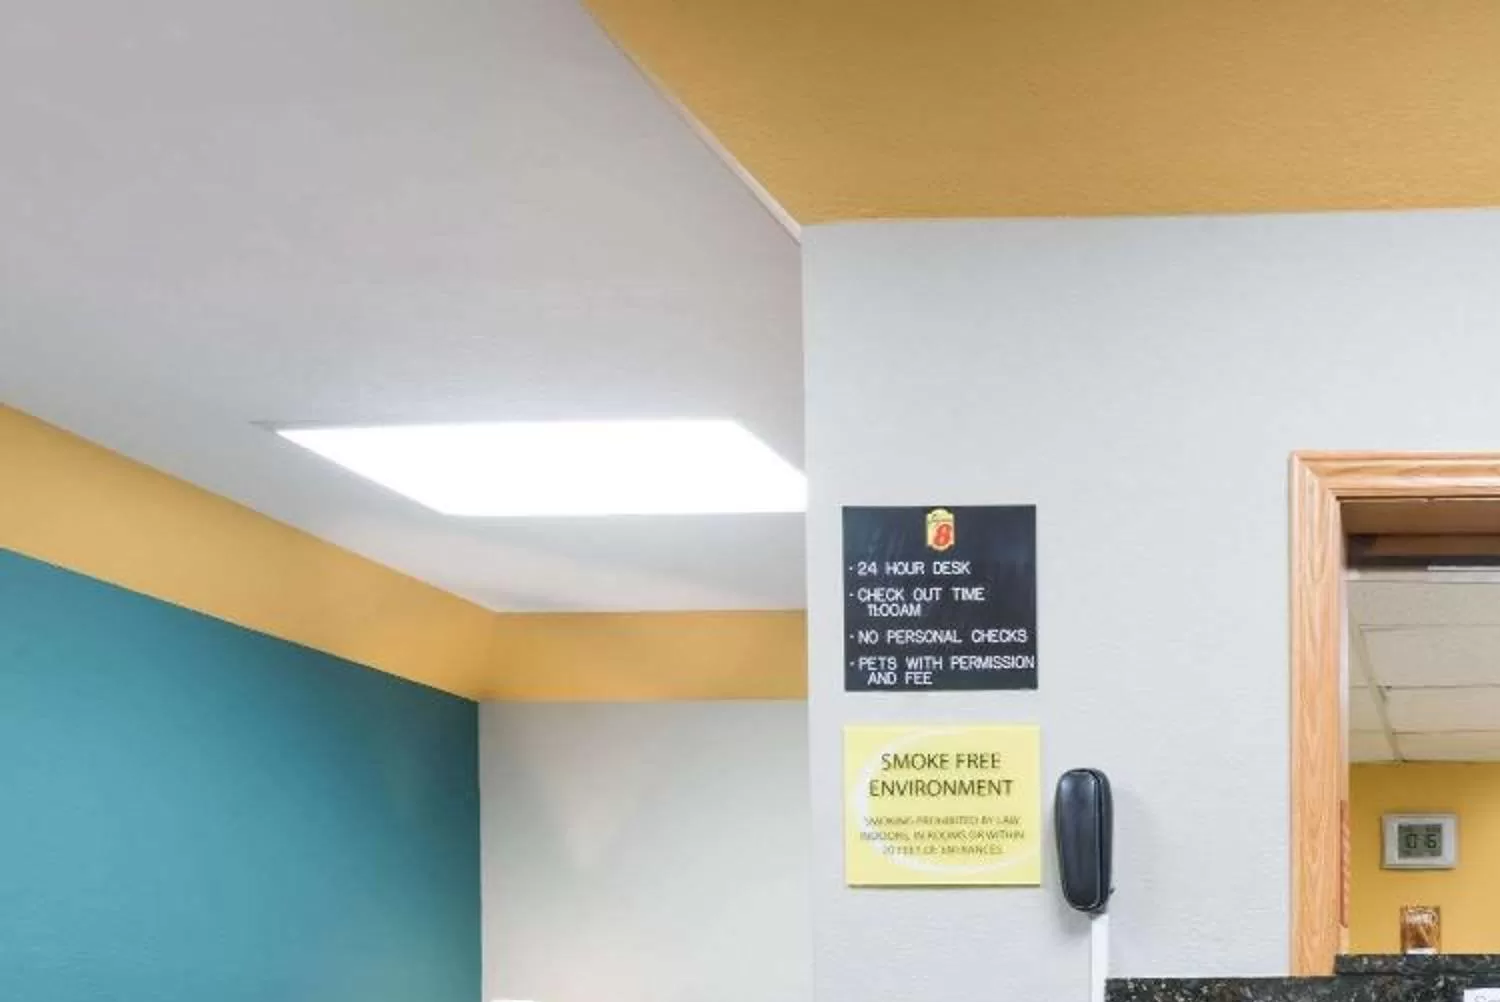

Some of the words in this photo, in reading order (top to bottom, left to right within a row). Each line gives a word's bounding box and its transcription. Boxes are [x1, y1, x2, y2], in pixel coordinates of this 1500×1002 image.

[857, 562, 878, 575] 24
[886, 561, 925, 575] HOUR
[933, 561, 971, 575] DESK
[857, 588, 904, 602] CHECK
[913, 588, 942, 601] OUT
[952, 587, 985, 601] TIME
[858, 629, 879, 645] NO
[887, 629, 962, 645] PERSONAL
[971, 629, 1028, 644] CHECKS
[859, 656, 897, 671] PETS
[905, 655, 943, 671] WITH
[951, 655, 1035, 671] PERMISSION
[867, 671, 897, 685] AND
[905, 671, 933, 685] FEE
[881, 753, 949, 770] SMOKE
[955, 753, 1000, 769] FREE
[869, 779, 1014, 797] ENVIRONMENT
